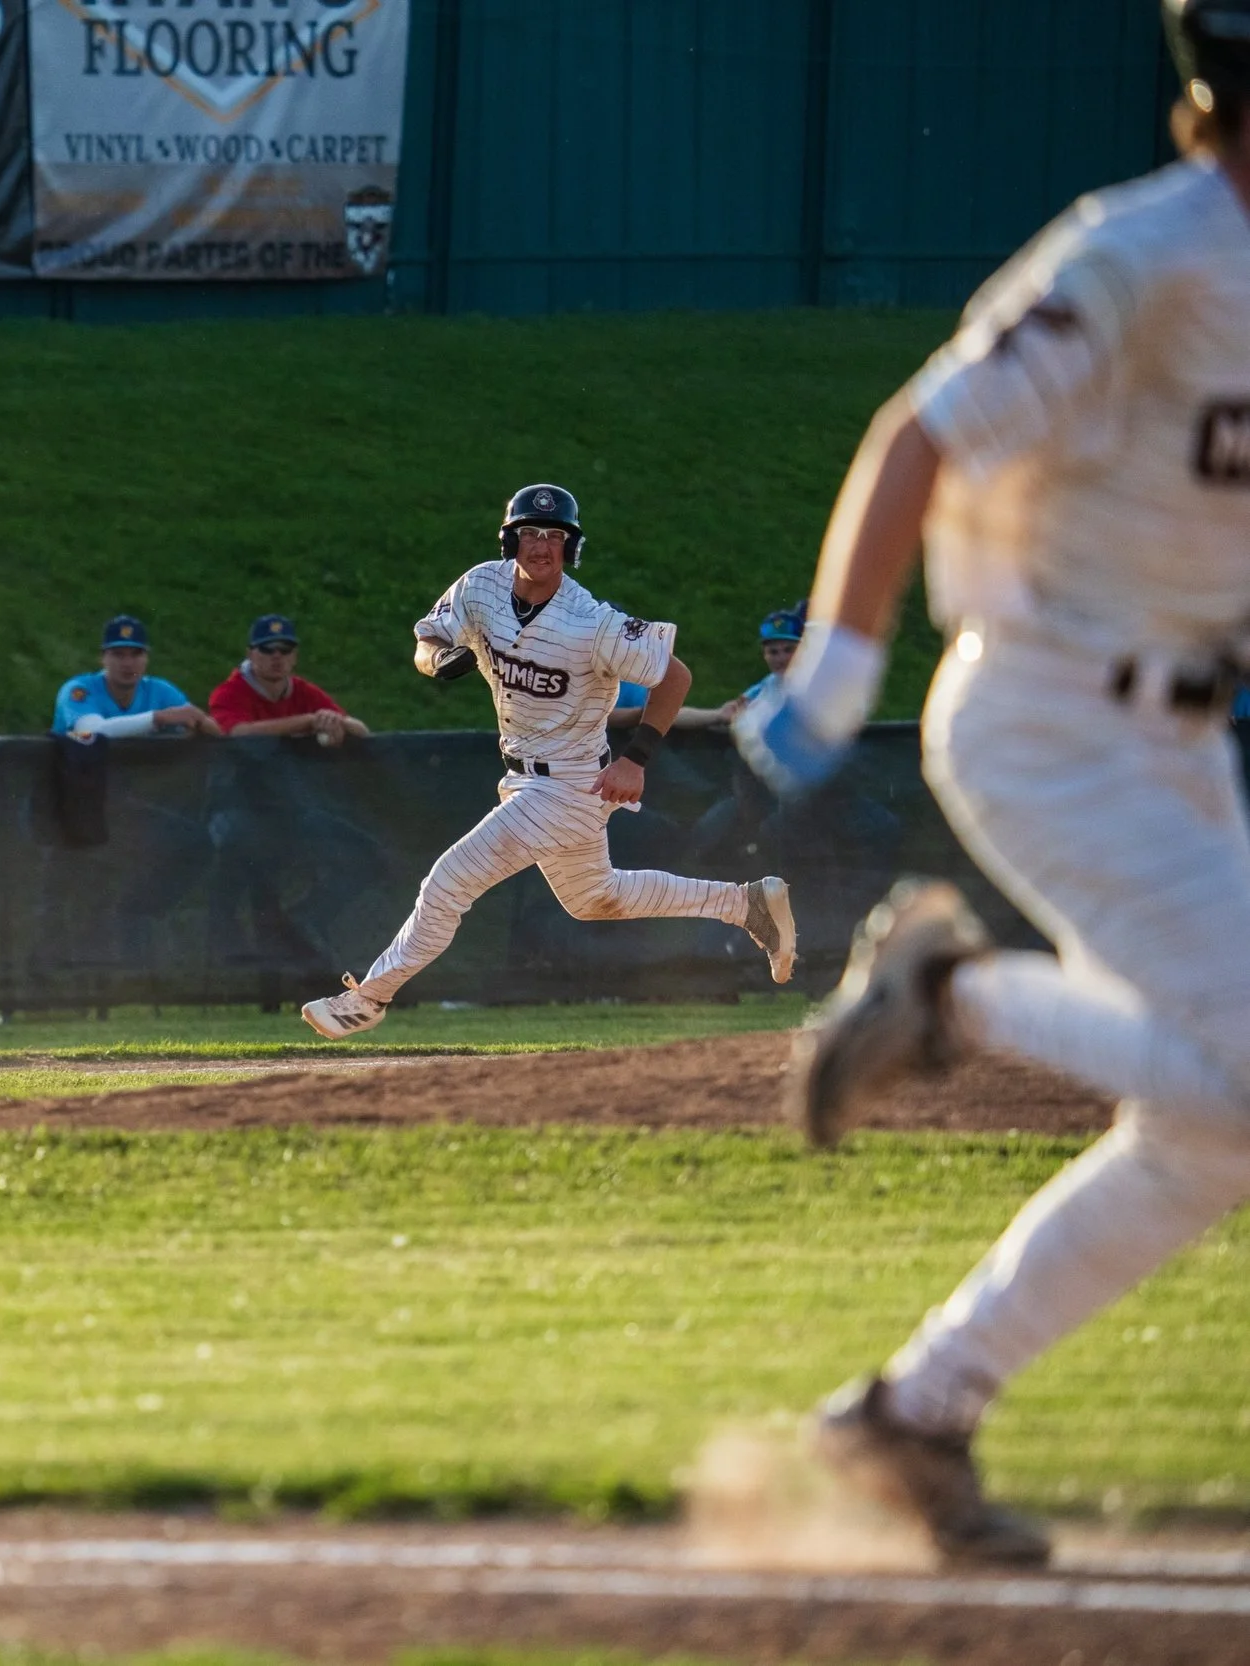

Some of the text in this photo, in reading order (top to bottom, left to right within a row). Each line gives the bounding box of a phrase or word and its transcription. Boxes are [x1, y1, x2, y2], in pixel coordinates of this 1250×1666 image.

[81, 18, 359, 78] FLOORING
[64, 133, 388, 164] VINYL WOOD CARPET
[258, 242, 292, 268] OF
[300, 242, 346, 268] THE
